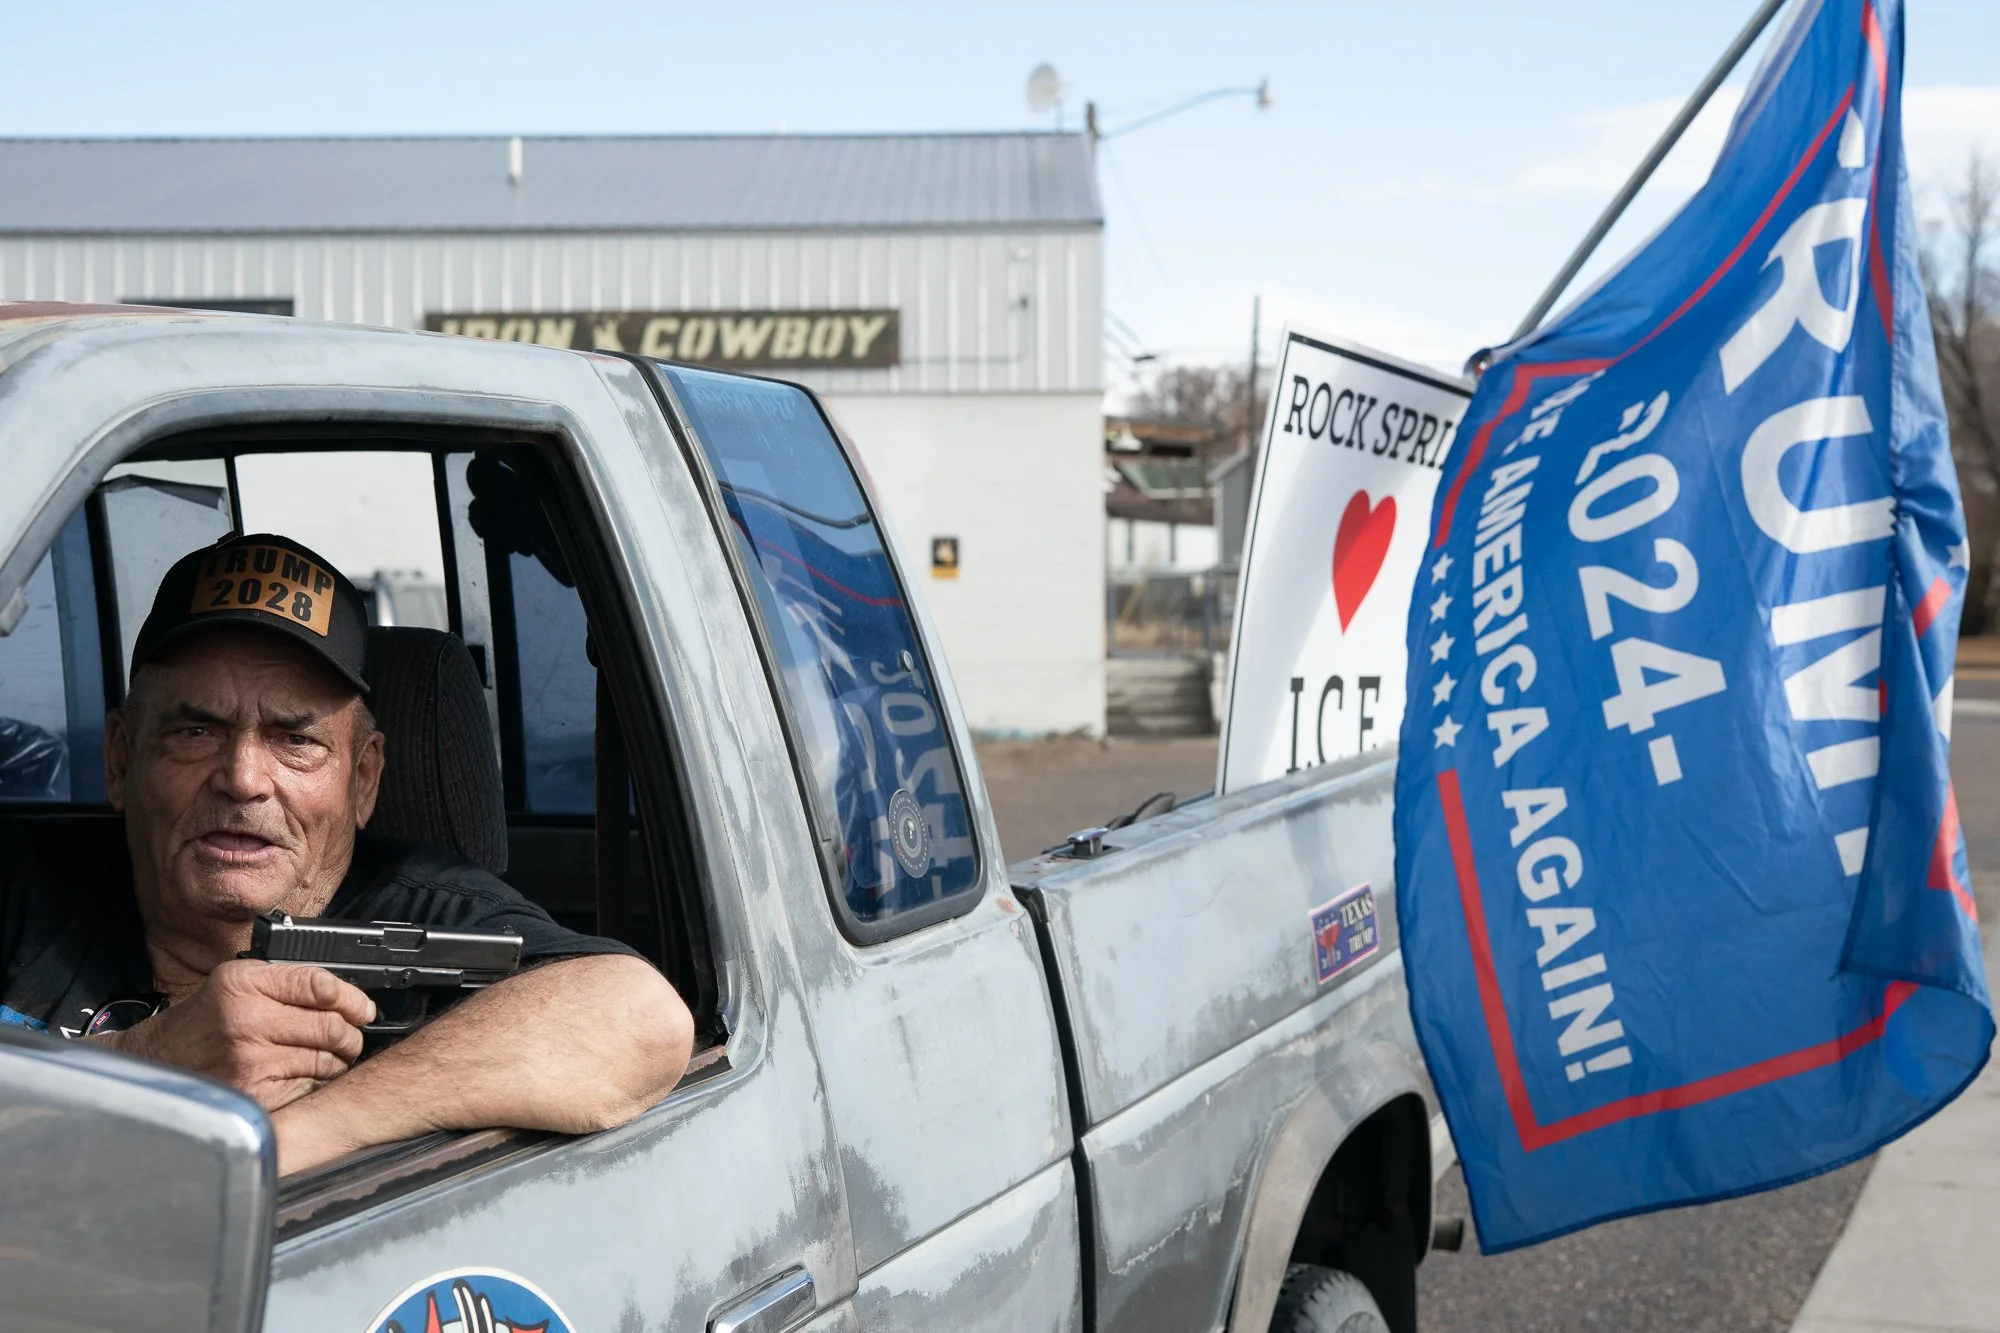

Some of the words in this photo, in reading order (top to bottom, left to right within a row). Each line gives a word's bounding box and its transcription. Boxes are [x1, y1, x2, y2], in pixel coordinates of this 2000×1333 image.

[640, 316, 887, 360] COWBOY
[1283, 375, 1379, 451] ROCK
[1373, 403, 1453, 469] SPRI
[1718, 106, 1896, 878] RUM
[206, 547, 332, 596] TRUMP
[210, 578, 313, 622] 2028
[1473, 455, 1549, 768] AMERICA
[1502, 787, 1633, 1082] AGAIN!
